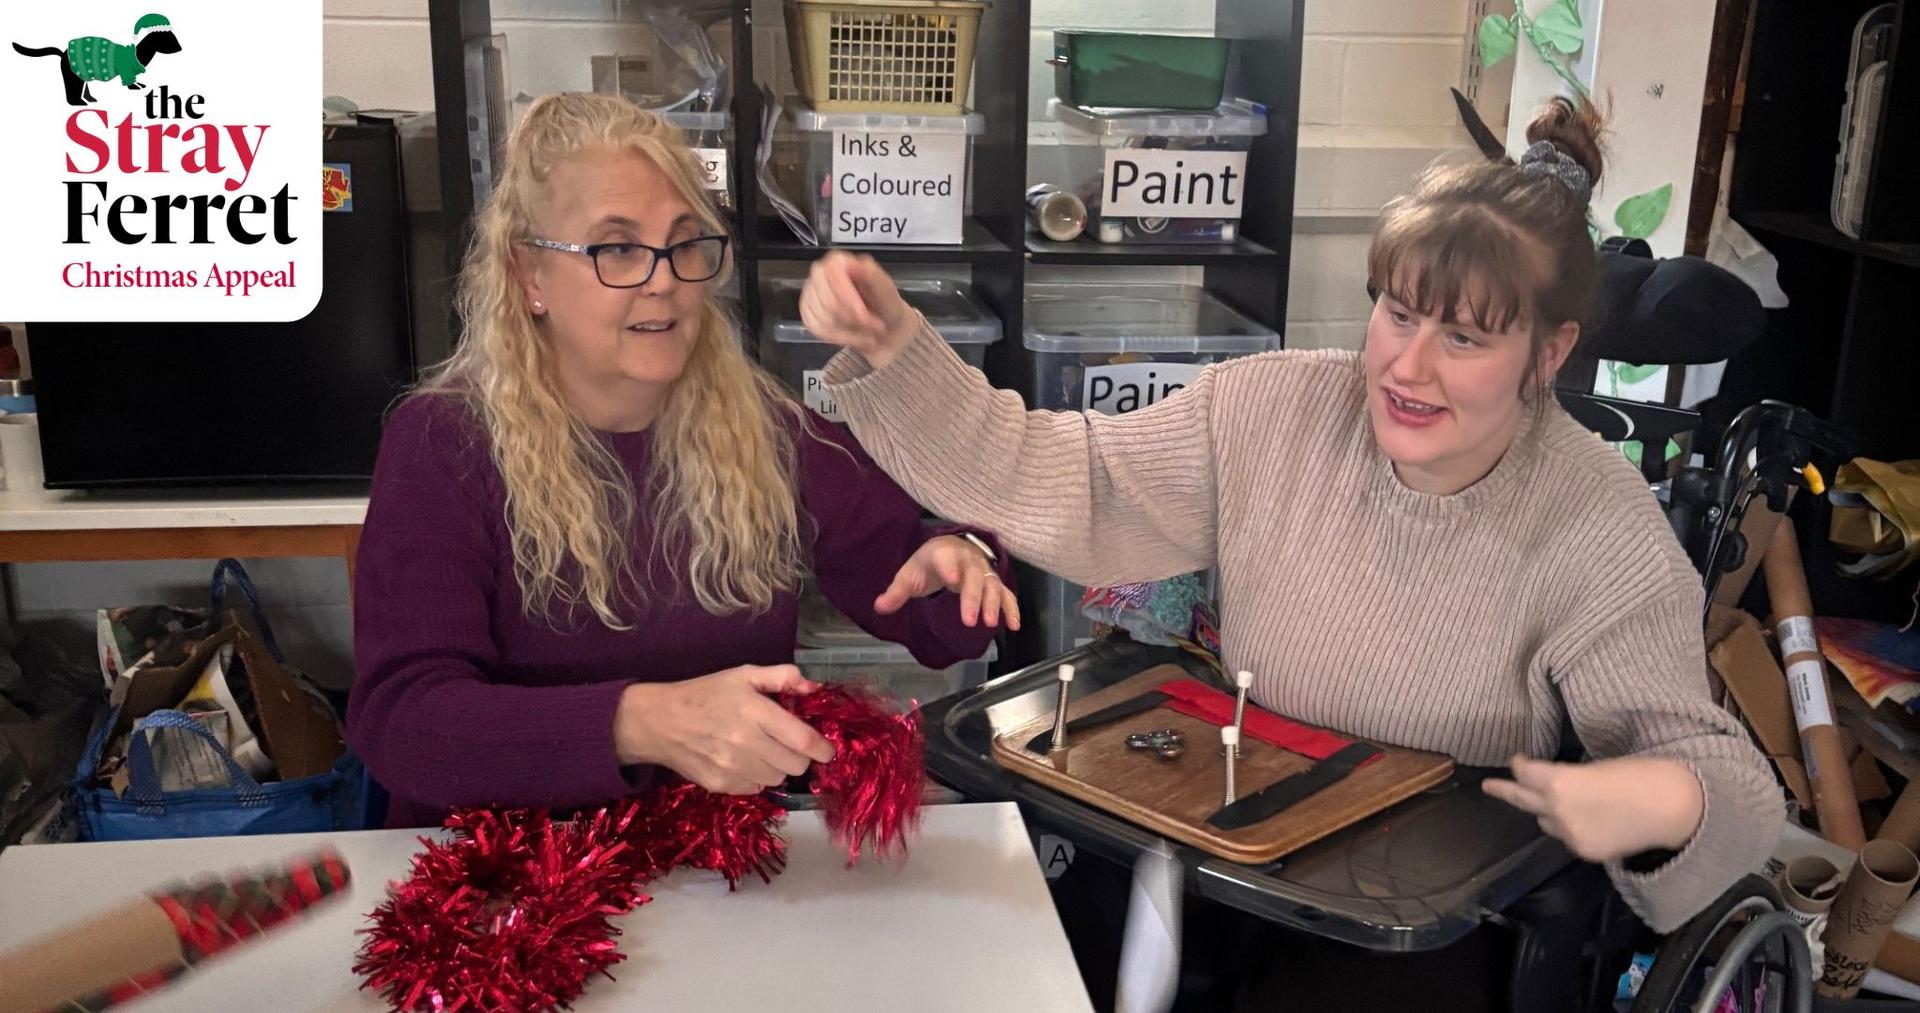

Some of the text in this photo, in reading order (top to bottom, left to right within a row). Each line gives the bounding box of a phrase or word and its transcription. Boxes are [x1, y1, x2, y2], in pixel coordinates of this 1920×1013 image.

[841, 132, 918, 158] Inks &
[839, 172, 952, 197] Coloured
[1110, 160, 1238, 205] Paint
[838, 210, 908, 239] Spray
